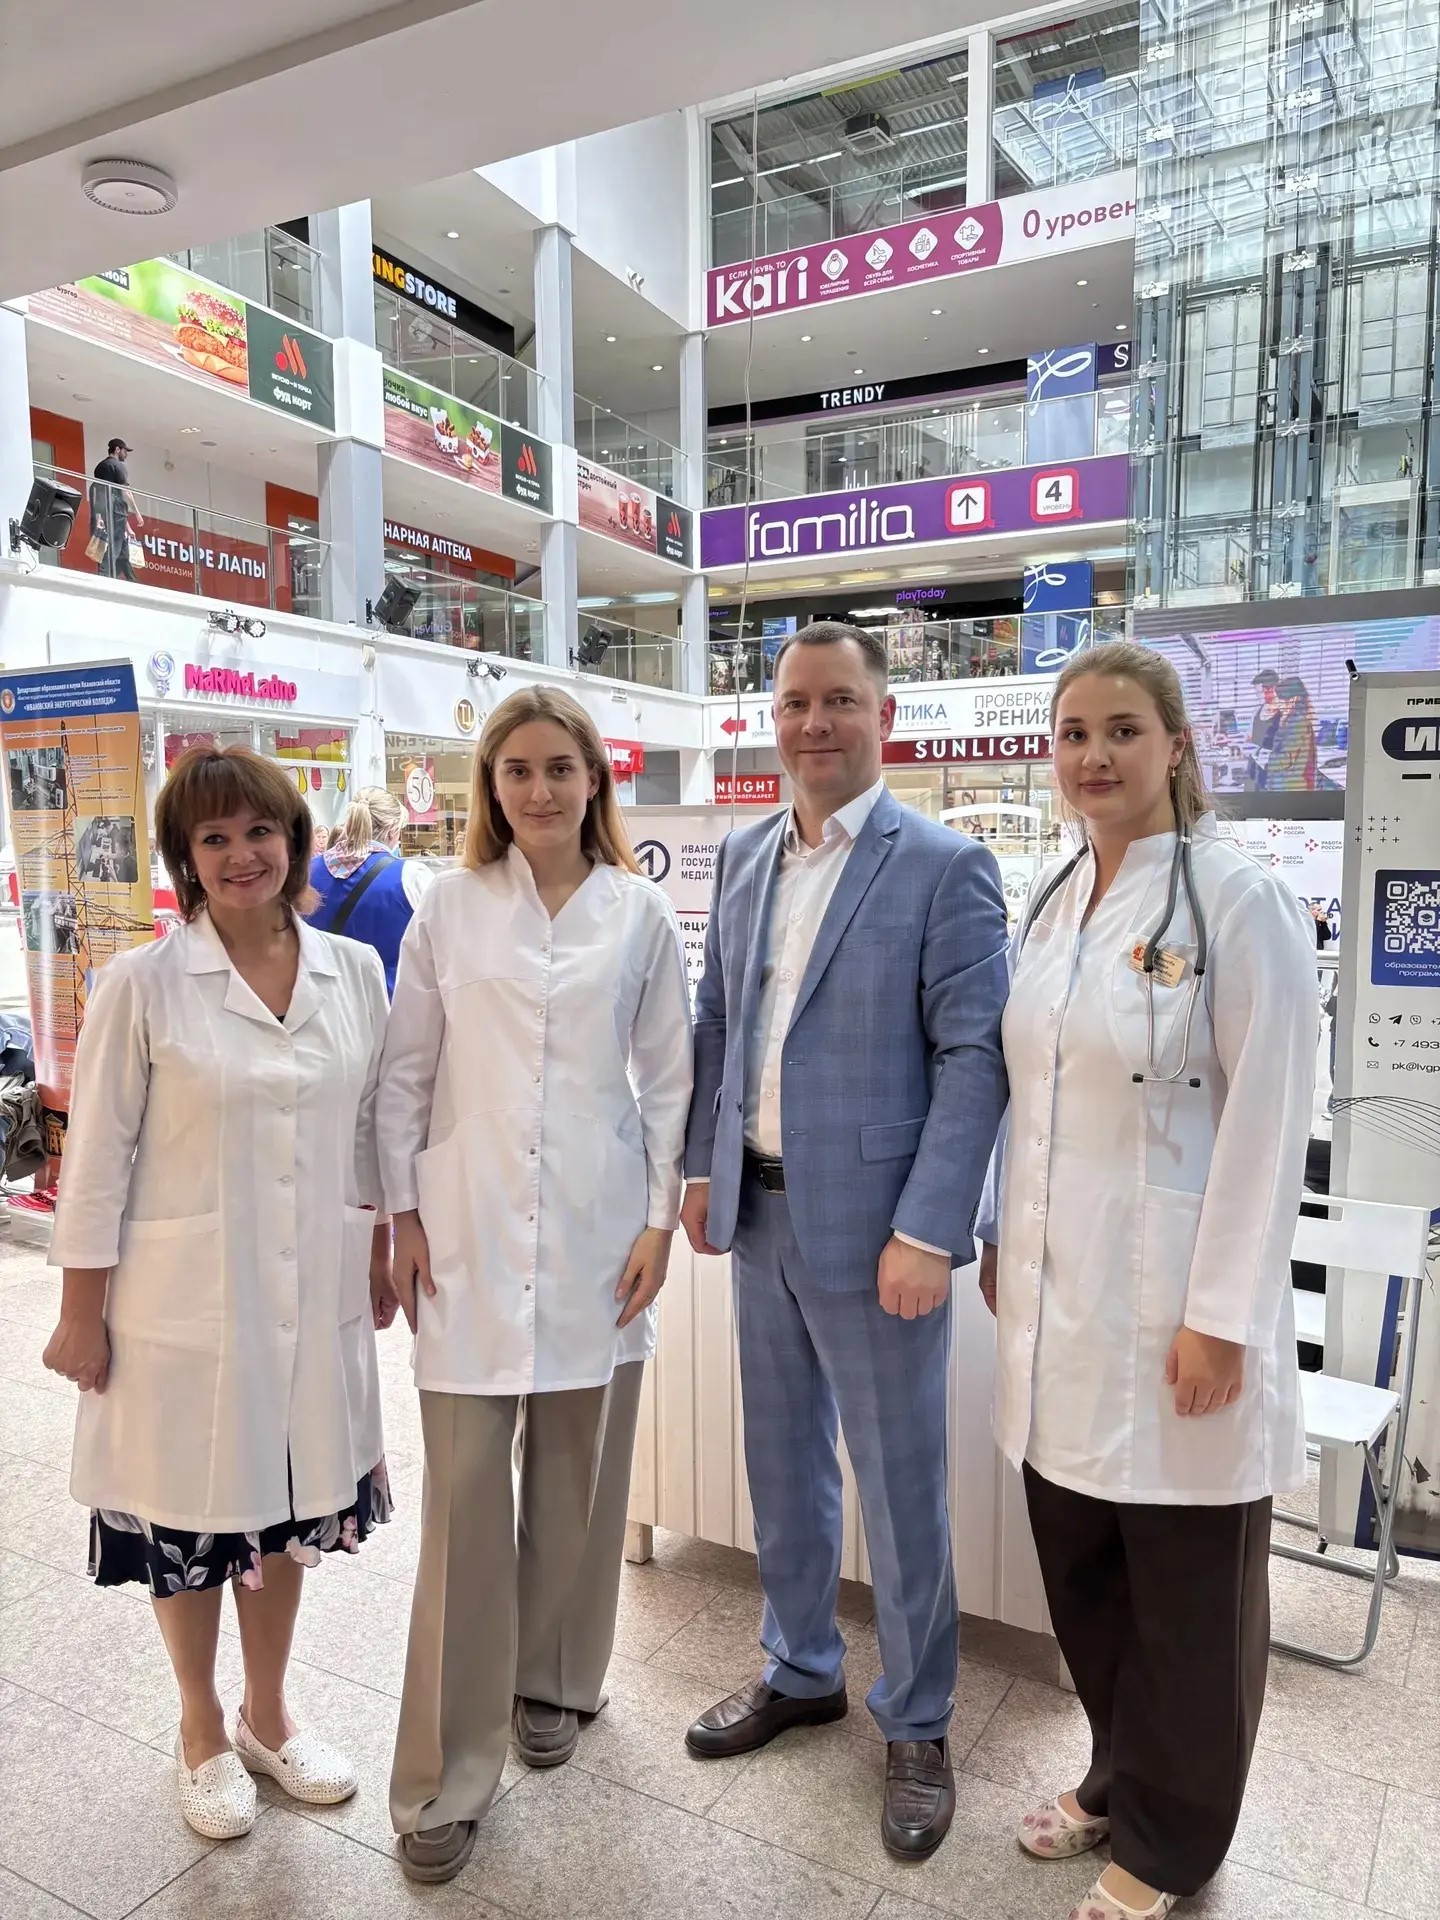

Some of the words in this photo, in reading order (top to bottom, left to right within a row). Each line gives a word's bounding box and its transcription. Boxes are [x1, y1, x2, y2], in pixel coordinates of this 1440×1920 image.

[950, 248, 986, 261] СПОРТИВНЫЕ
[958, 256, 980, 266] ТОВАРЫ
[729, 270, 748, 281] ЕСЛИ
[776, 260, 787, 269] ТО
[907, 261, 938, 273] КОСМЕТИКА
[716, 256, 809, 318] kari
[820, 384, 885, 409] TRENDY
[1045, 480, 1062, 502] 4
[749, 497, 916, 559] familia
[384, 521, 429, 550] НАРНАЯ
[431, 537, 473, 562] АПТЕКА
[144, 534, 214, 569] ЧЕТЫРЕ
[218, 552, 266, 579] ЛАПЫ
[896, 588, 947, 604] playToday
[757, 710, 764, 729] 1
[915, 736, 1053, 759] SUNLIGHT
[1394, 1039, 1405, 1048] +7
[1412, 1041, 1440, 1049] 493
